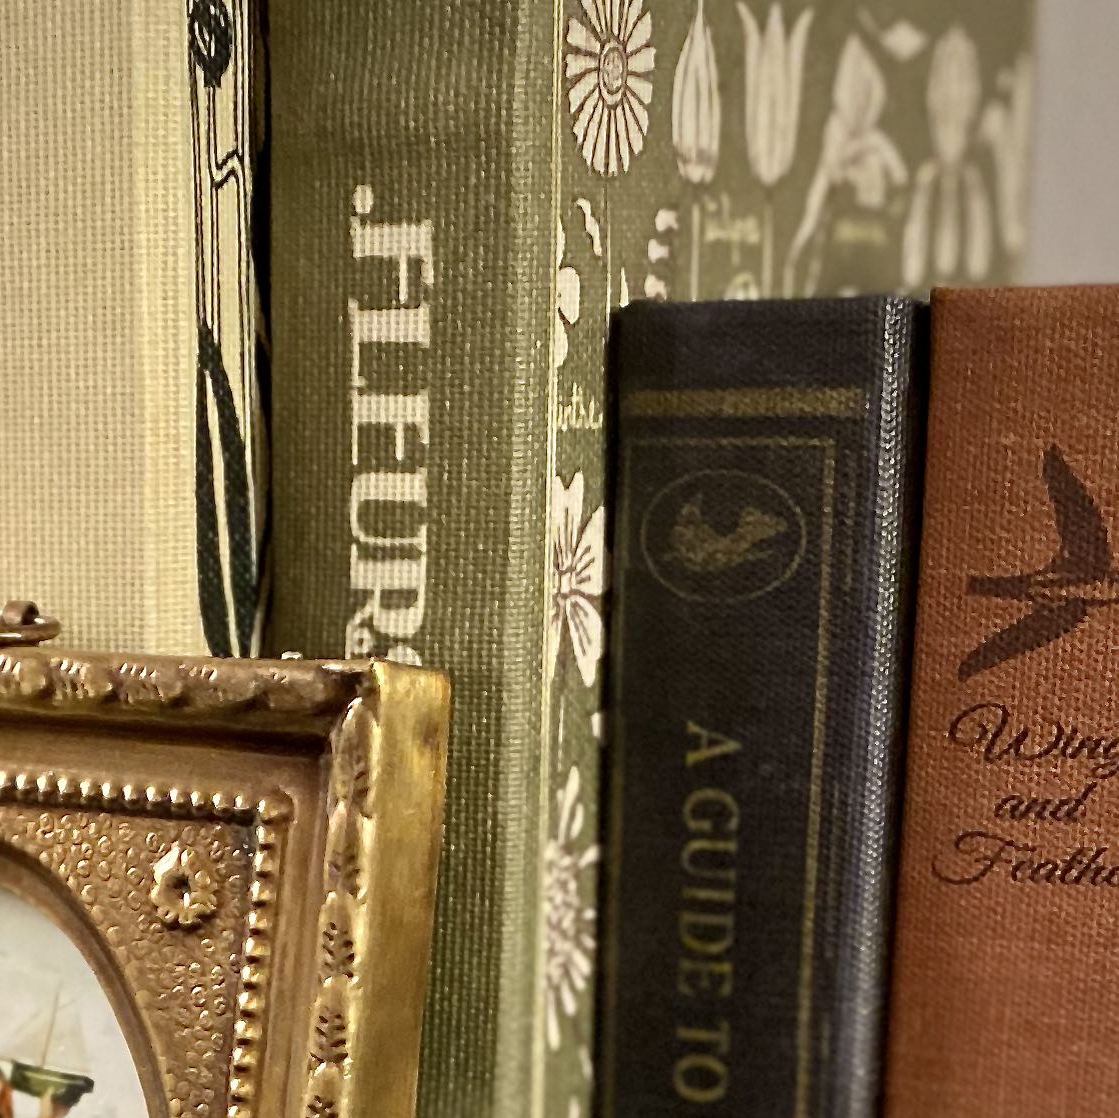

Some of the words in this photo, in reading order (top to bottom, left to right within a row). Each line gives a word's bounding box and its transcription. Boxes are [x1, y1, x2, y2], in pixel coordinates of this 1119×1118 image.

[686, 721, 742, 763] A
[994, 781, 1098, 822] and
[677, 787, 741, 996] GUIDE
[671, 1017, 732, 1103] TO
